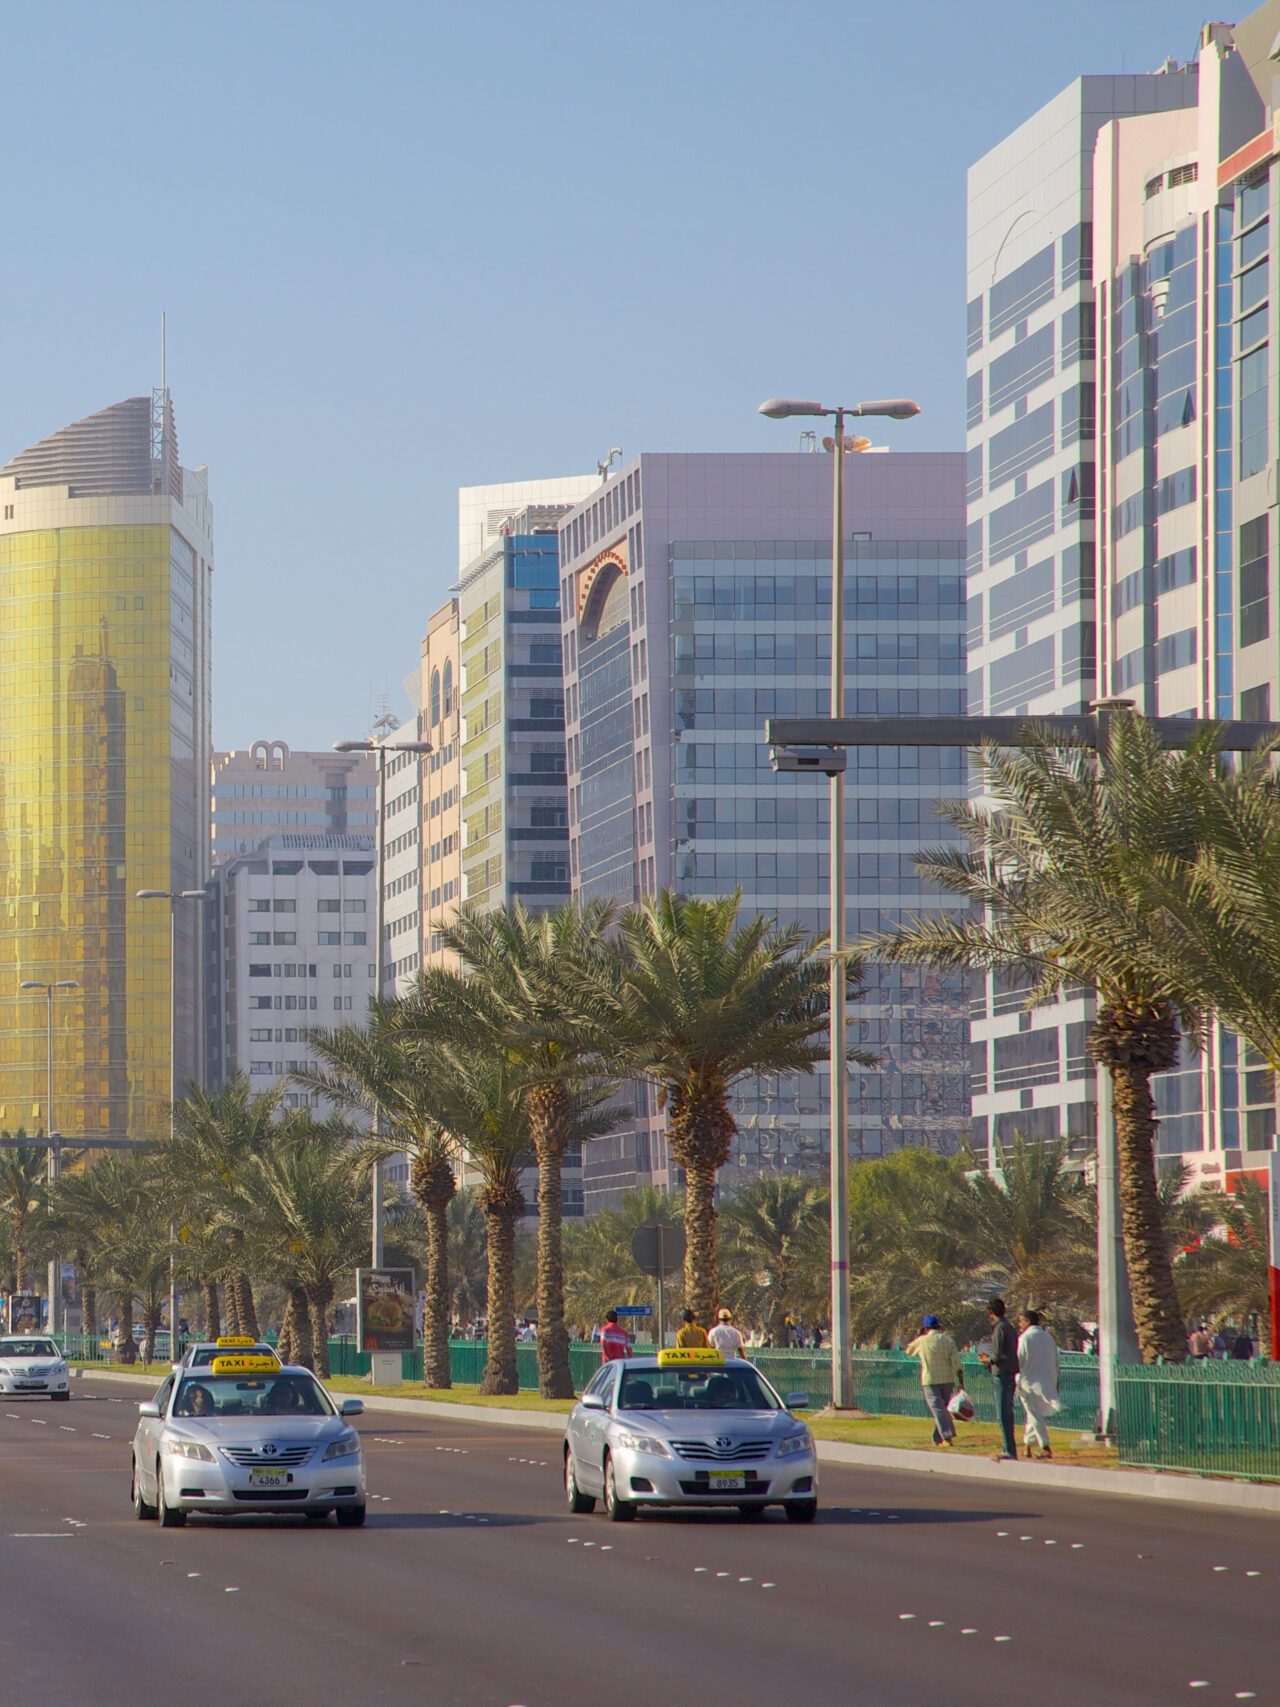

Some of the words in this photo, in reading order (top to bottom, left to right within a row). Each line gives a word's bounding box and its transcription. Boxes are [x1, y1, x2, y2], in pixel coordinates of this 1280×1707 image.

[695, 1351, 720, 1360] أجرة
[259, 1476, 280, 1485] 4366
[717, 1478, 738, 1488] 8935
